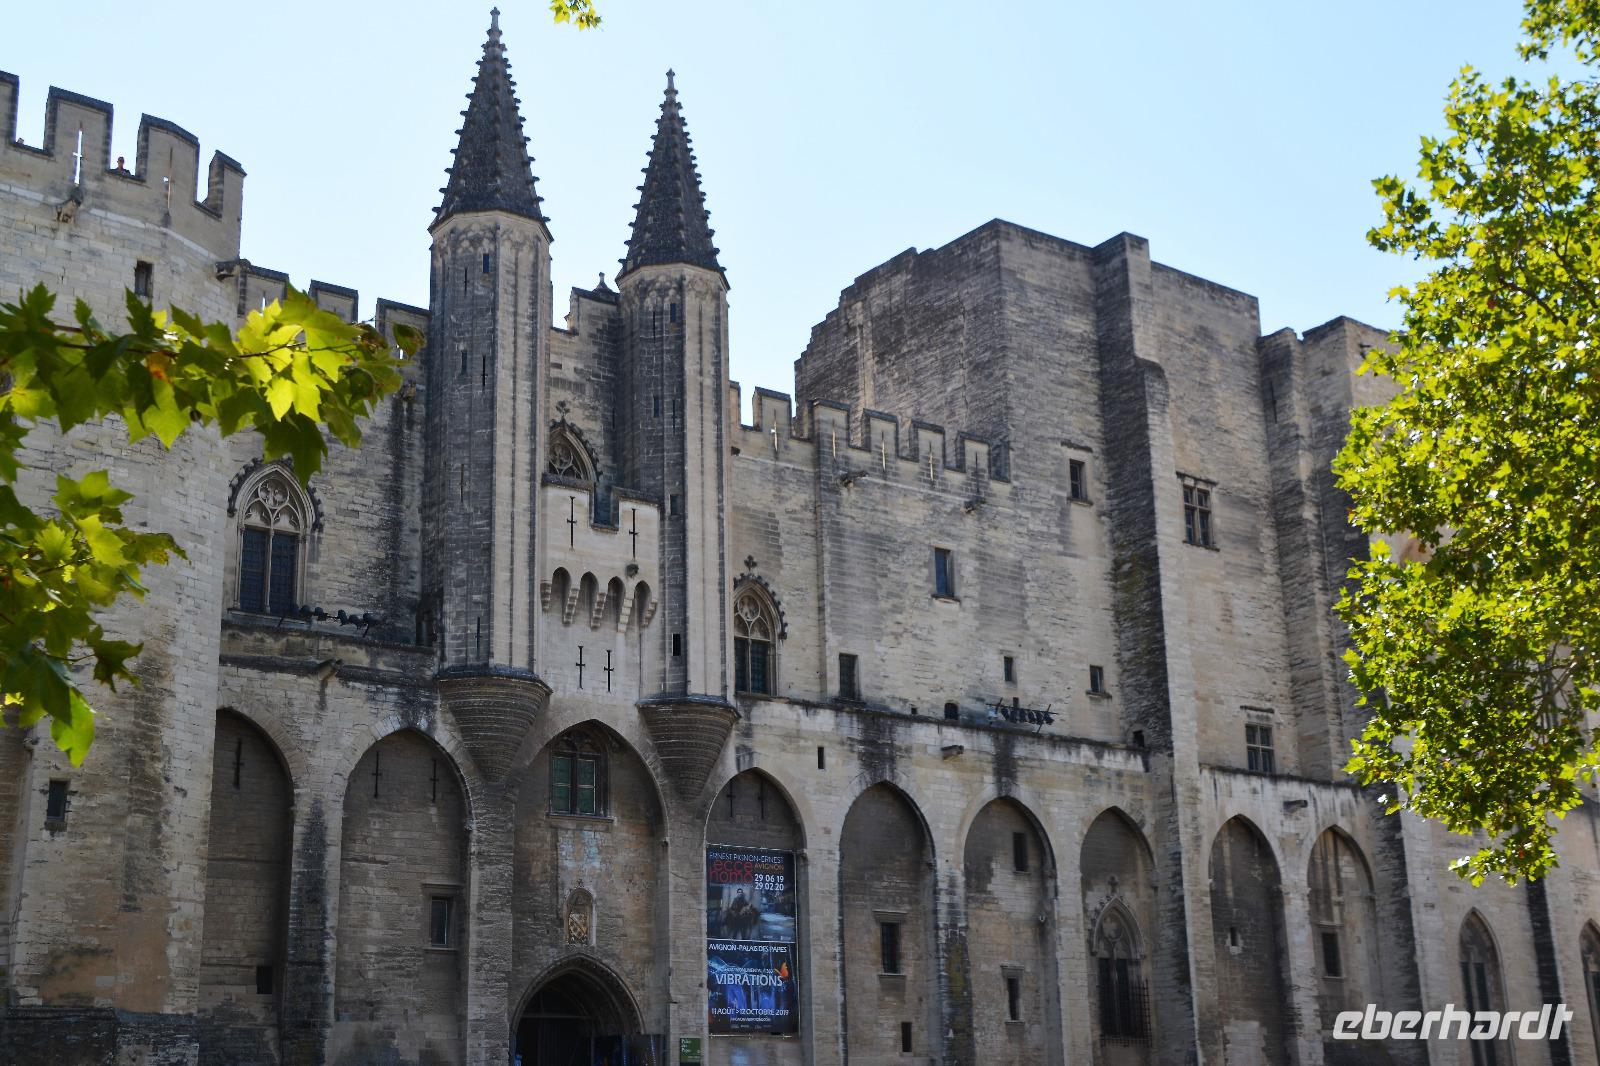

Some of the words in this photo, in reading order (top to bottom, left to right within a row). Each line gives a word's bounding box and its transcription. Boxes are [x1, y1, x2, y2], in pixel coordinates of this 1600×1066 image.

[709, 852, 732, 860] ERNEST
[713, 860, 753, 872] ecce
[754, 863, 784, 871] AVIGNON
[709, 866, 754, 884] homo
[754, 874, 764, 882] 29
[777, 875, 784, 883] 19
[754, 882, 764, 890] 29
[774, 883, 784, 891] 20
[715, 973, 783, 987] VIBRATIONS
[717, 1006, 735, 1015] AOÛT
[745, 1008, 775, 1016] OCTOBRE
